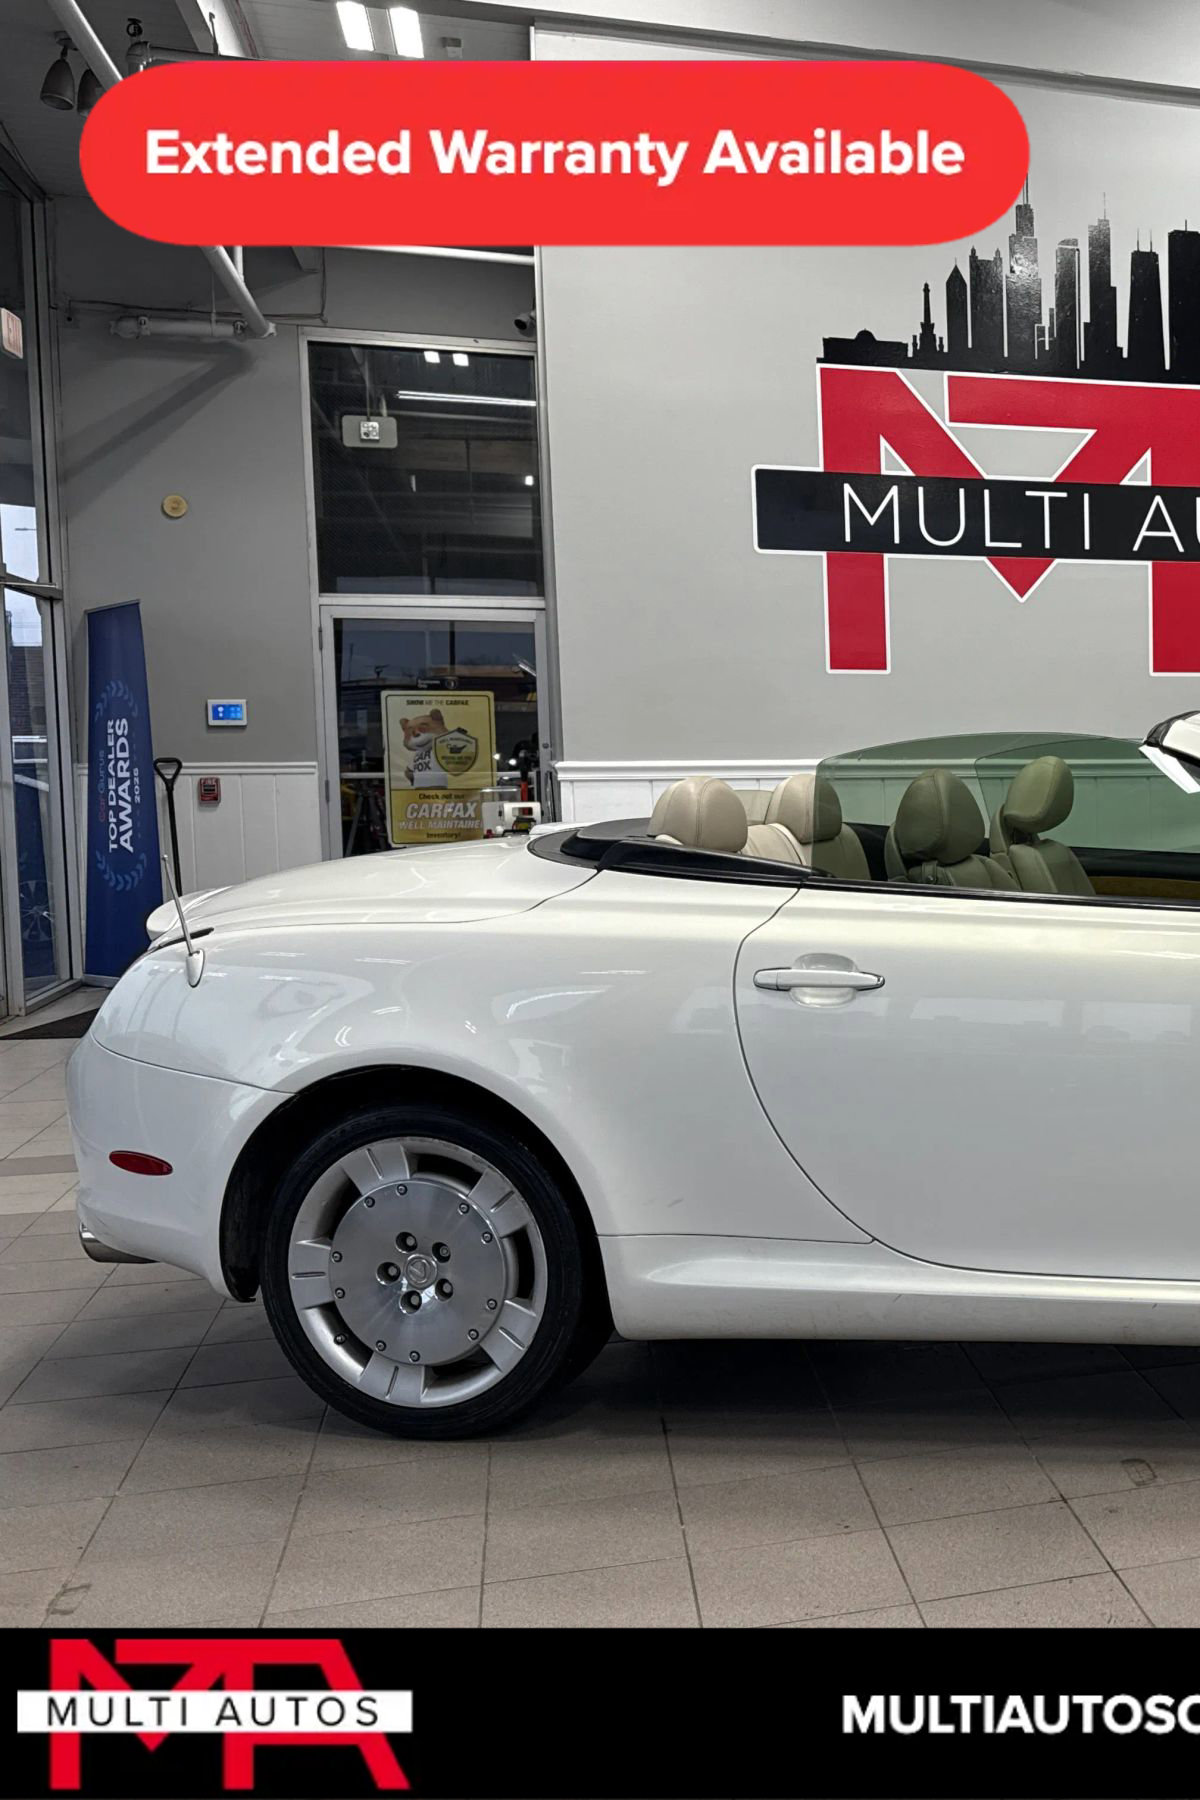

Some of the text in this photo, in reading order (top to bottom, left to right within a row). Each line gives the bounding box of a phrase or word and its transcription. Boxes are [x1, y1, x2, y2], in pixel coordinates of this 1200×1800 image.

[841, 482, 1091, 551] MULTI
[107, 719, 118, 853] TOP DEALER
[115, 718, 134, 854] AWARDS
[406, 802, 477, 819] CARFAX
[399, 819, 482, 830] WELL MAINTAINE
